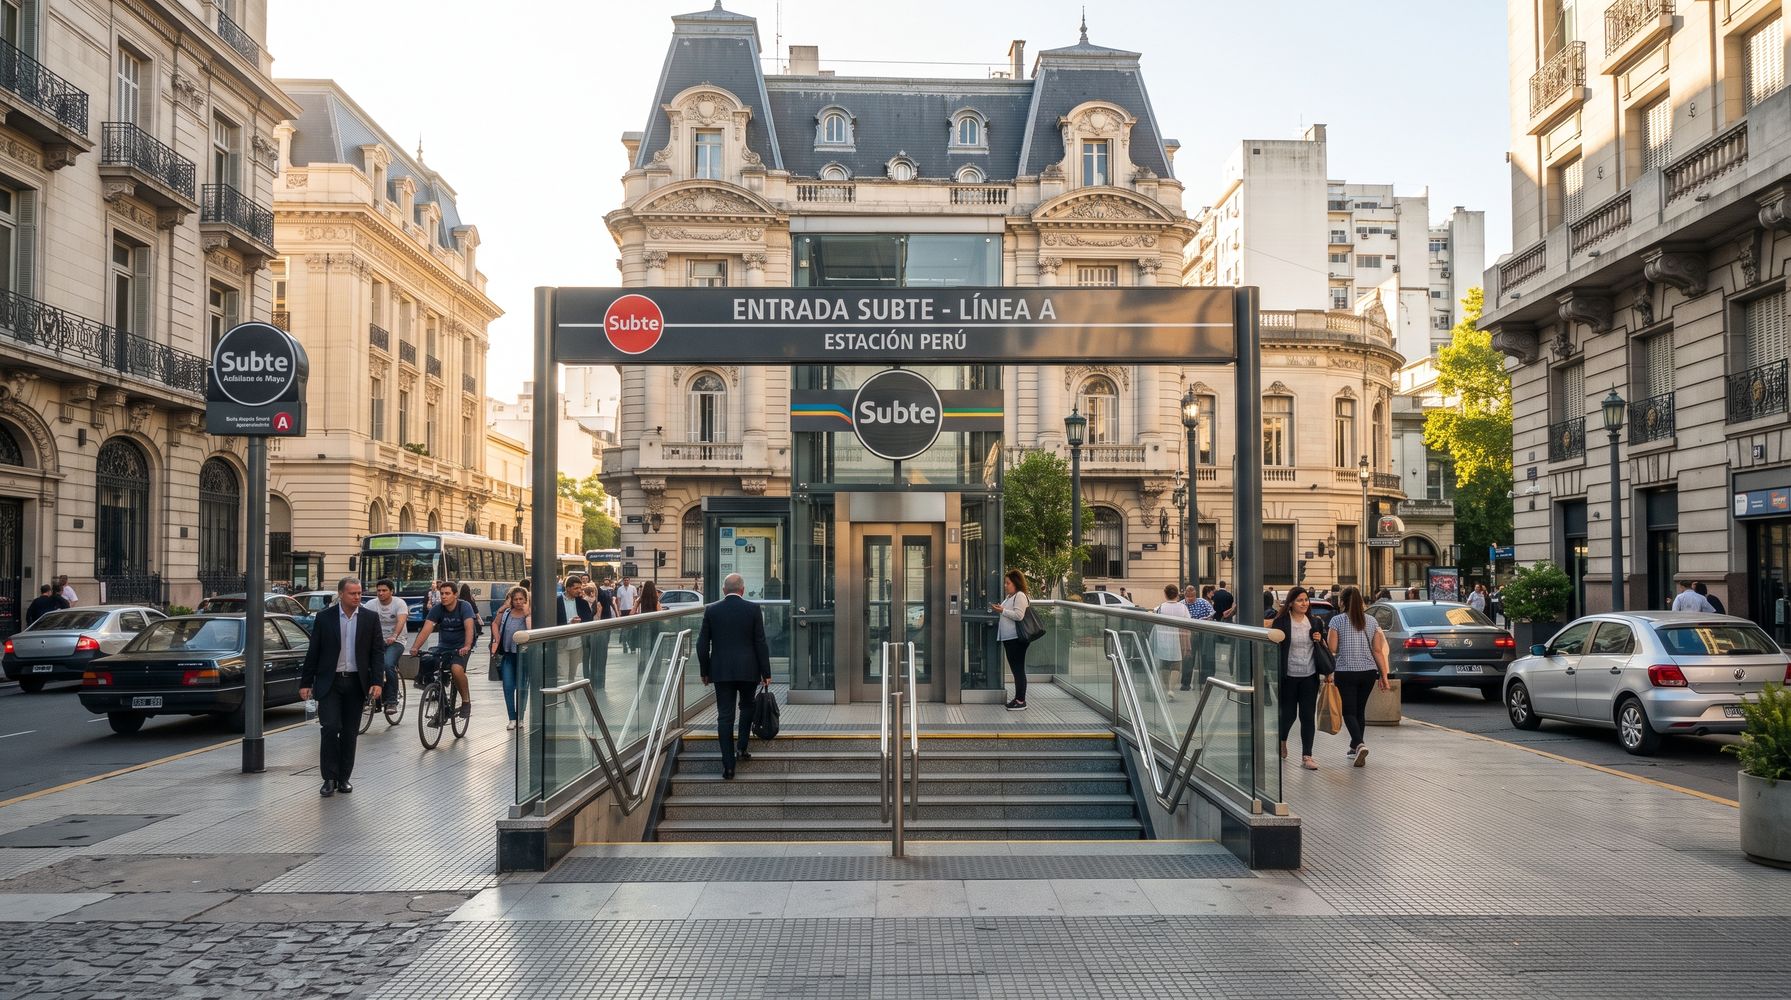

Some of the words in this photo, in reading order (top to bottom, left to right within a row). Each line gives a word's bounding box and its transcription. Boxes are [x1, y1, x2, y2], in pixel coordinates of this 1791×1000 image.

[733, 298, 848, 320] ENTRADA
[857, 298, 934, 321] SUBTE
[959, 292, 1032, 320] LÍNEA
[1038, 299, 1057, 321] A
[609, 314, 660, 332] Subte
[824, 330, 914, 350] ESTACIÓN
[920, 330, 967, 350] PERÚ
[221, 351, 288, 372] Subte
[277, 416, 288, 429] A
[859, 400, 936, 425] Subte
